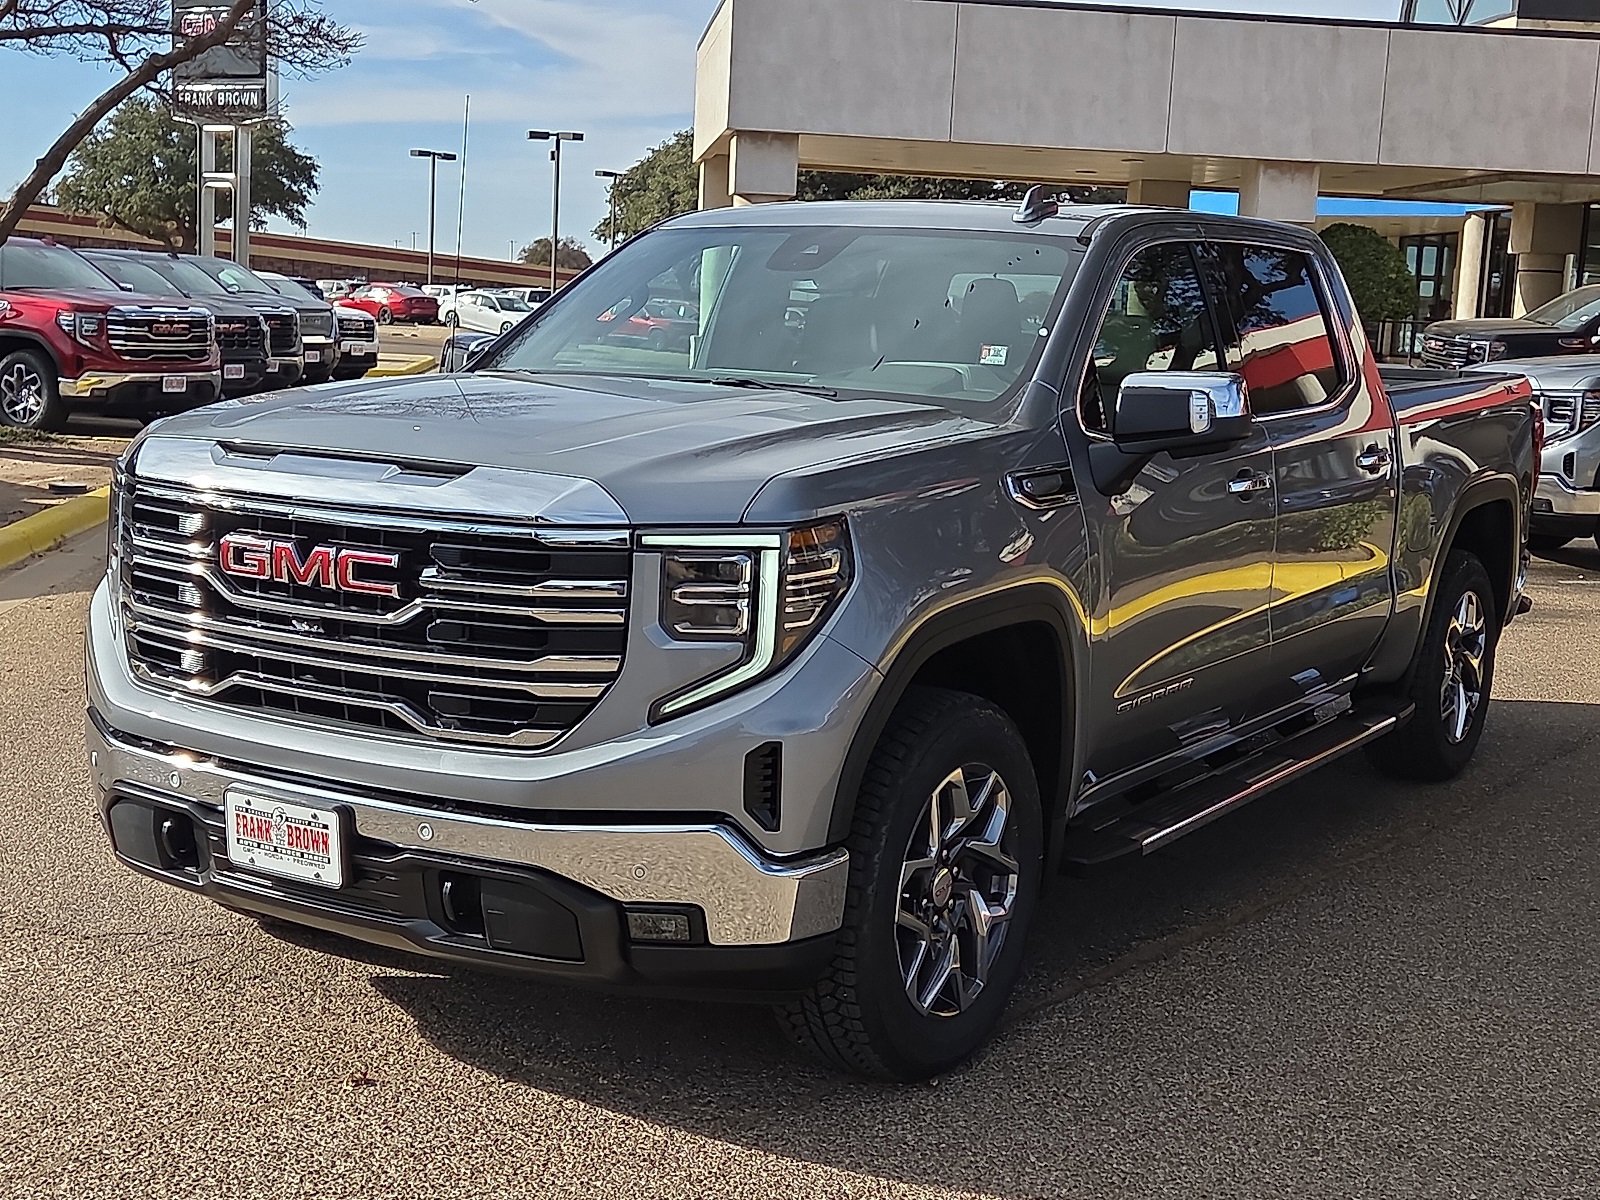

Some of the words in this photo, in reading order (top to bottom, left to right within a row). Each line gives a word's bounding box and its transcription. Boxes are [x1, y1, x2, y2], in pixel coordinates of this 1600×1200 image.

[178, 91, 213, 106] FRANK
[217, 91, 258, 106] BROWN
[219, 533, 400, 599] GMC
[1116, 677, 1195, 715] SIERRA
[235, 813, 273, 843] FRANK
[286, 824, 329, 855] BROWN
[239, 839, 258, 848] AUTO
[260, 843, 275, 851] AND
